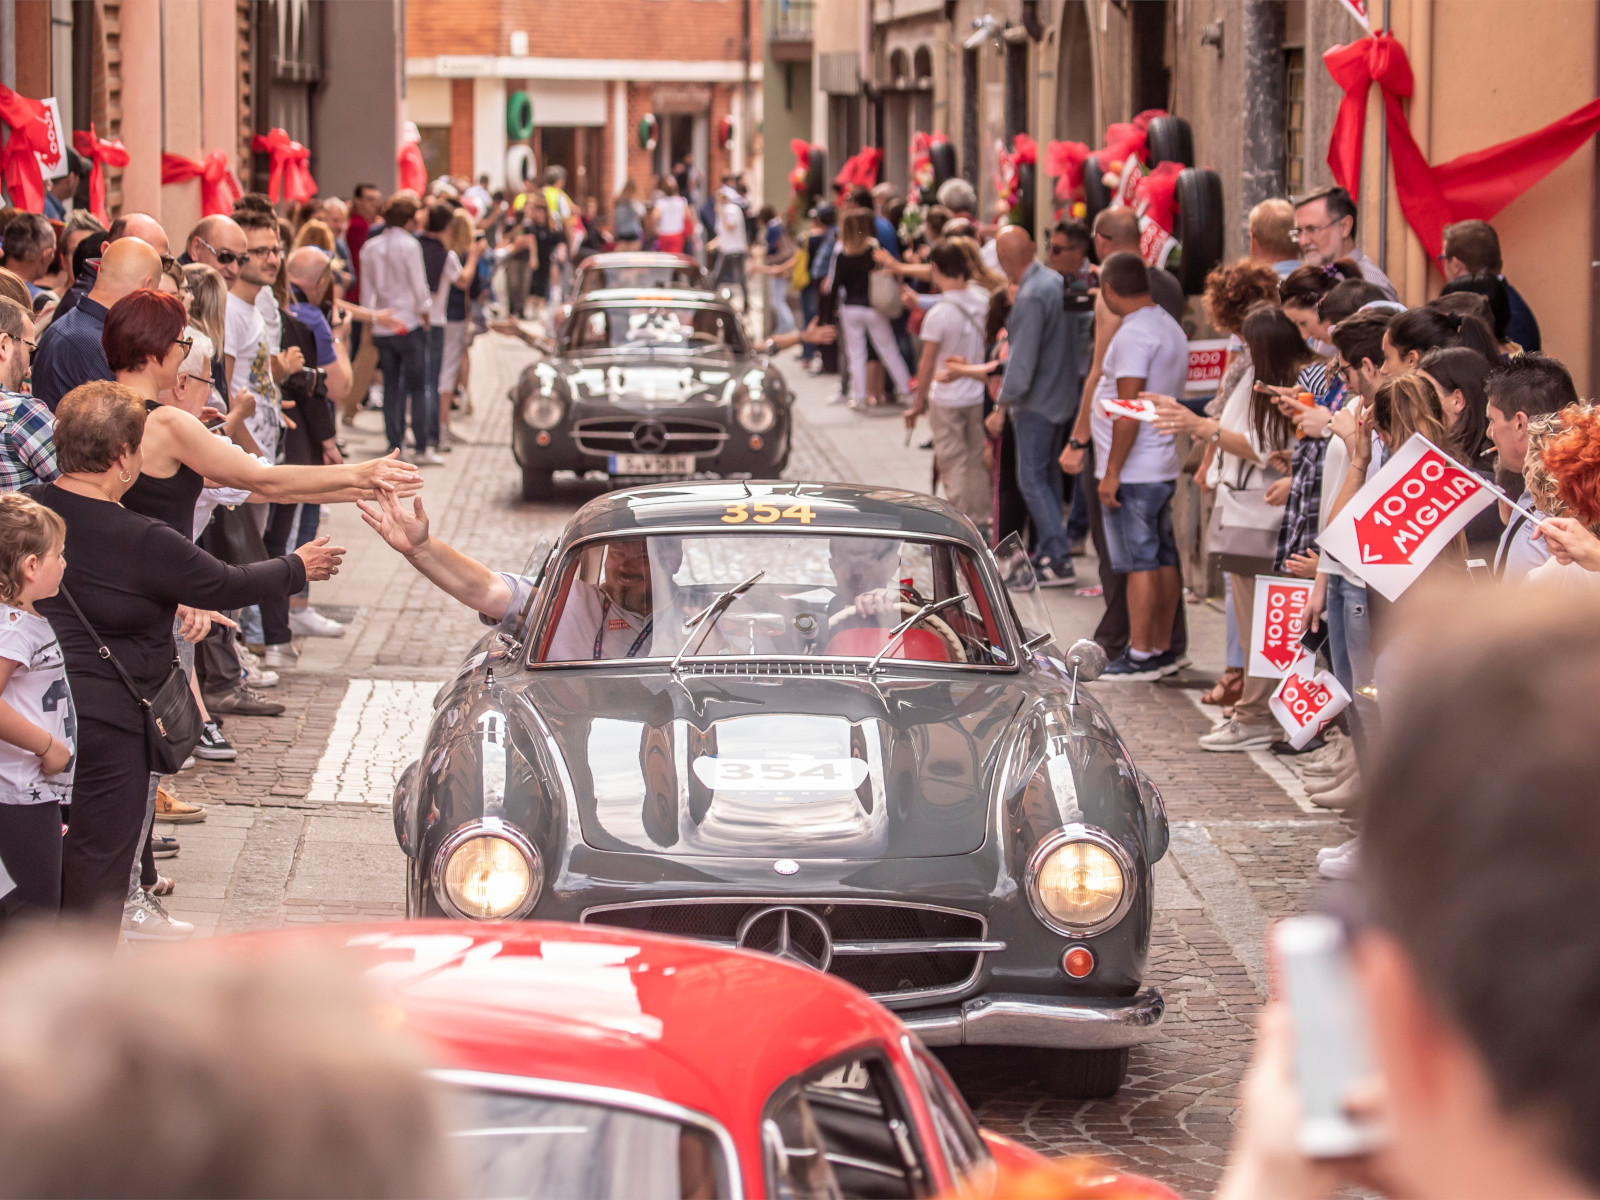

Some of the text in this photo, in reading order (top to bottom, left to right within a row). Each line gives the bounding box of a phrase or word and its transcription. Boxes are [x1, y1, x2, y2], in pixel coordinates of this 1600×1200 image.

[1189, 351, 1221, 366] 000
[1189, 366, 1221, 379] IGLIA
[720, 501, 817, 524] 354
[1373, 460, 1445, 527] 1000
[1392, 475, 1476, 554] MIGLIA
[1267, 592, 1286, 648] 1000
[1286, 590, 1307, 653] MIGLIA
[1283, 687, 1317, 726] 000
[719, 762, 843, 780] 354
